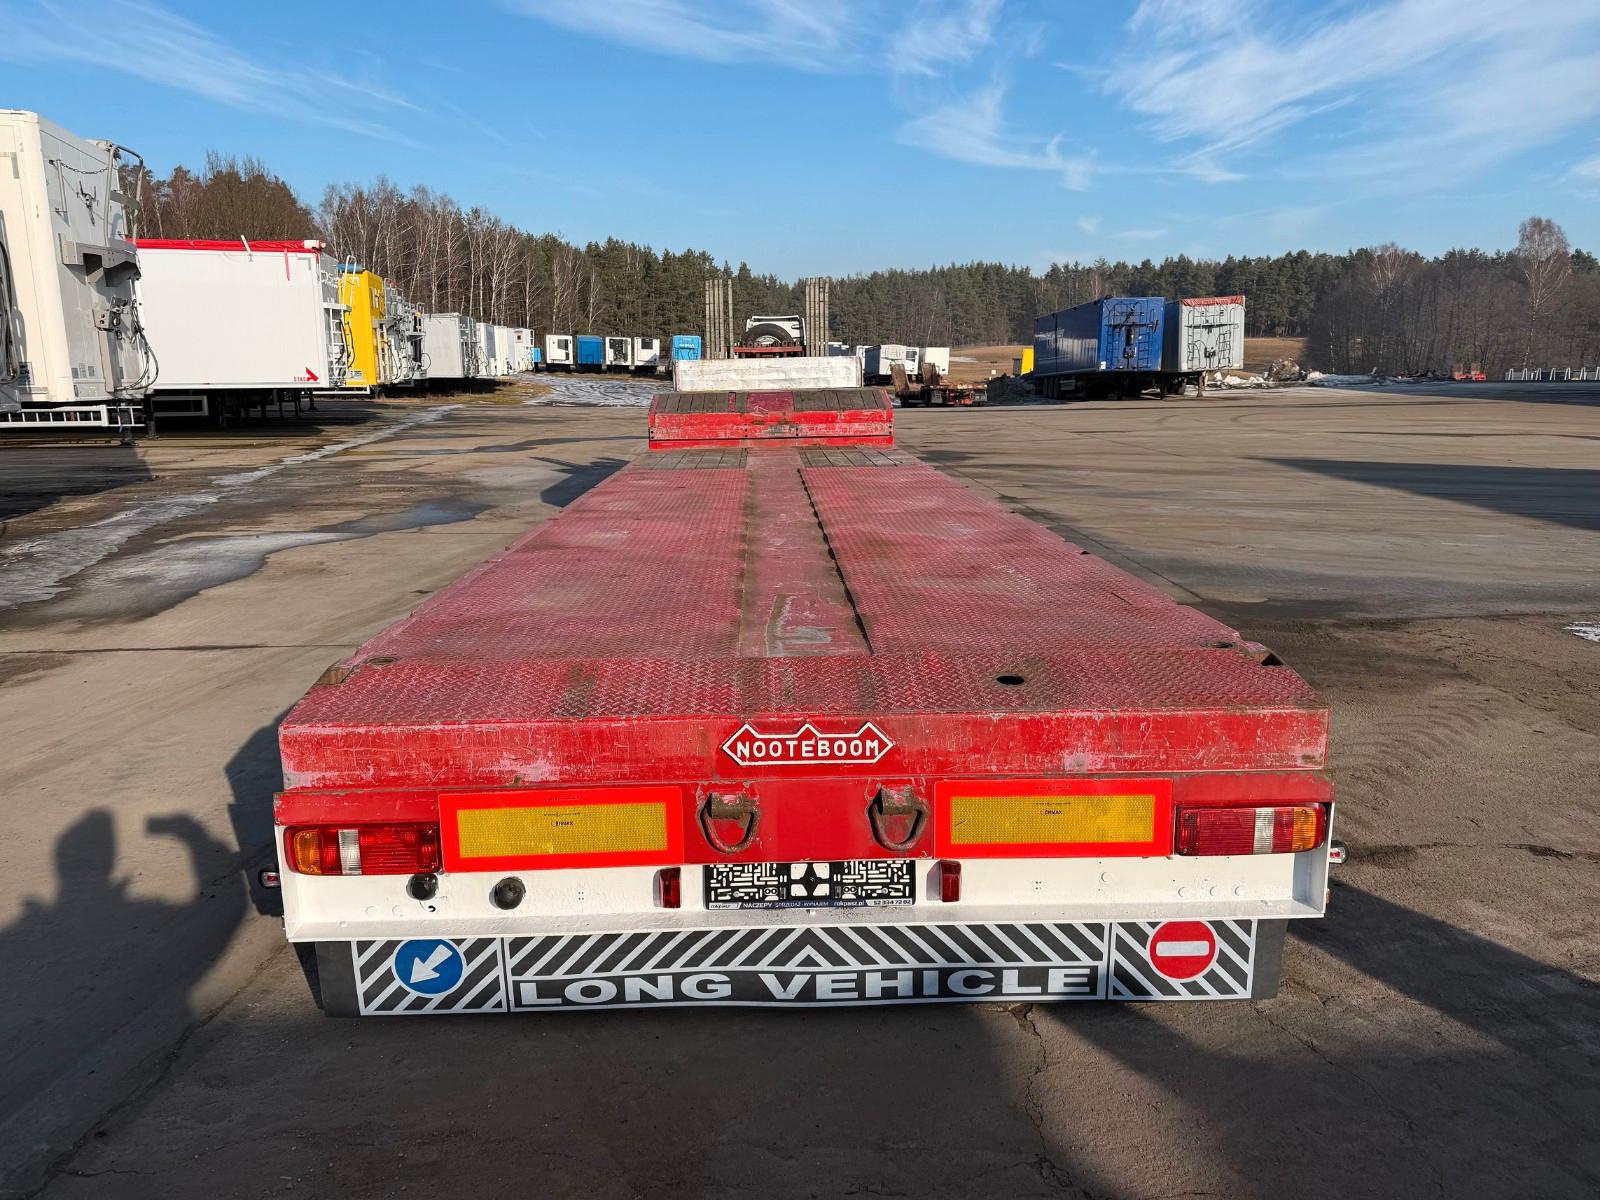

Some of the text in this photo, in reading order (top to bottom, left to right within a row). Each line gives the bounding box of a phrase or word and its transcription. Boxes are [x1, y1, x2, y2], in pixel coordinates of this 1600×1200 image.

[736, 739, 879, 758] NOOTEBOOM
[519, 968, 1091, 1005] LONG VEHICLE
